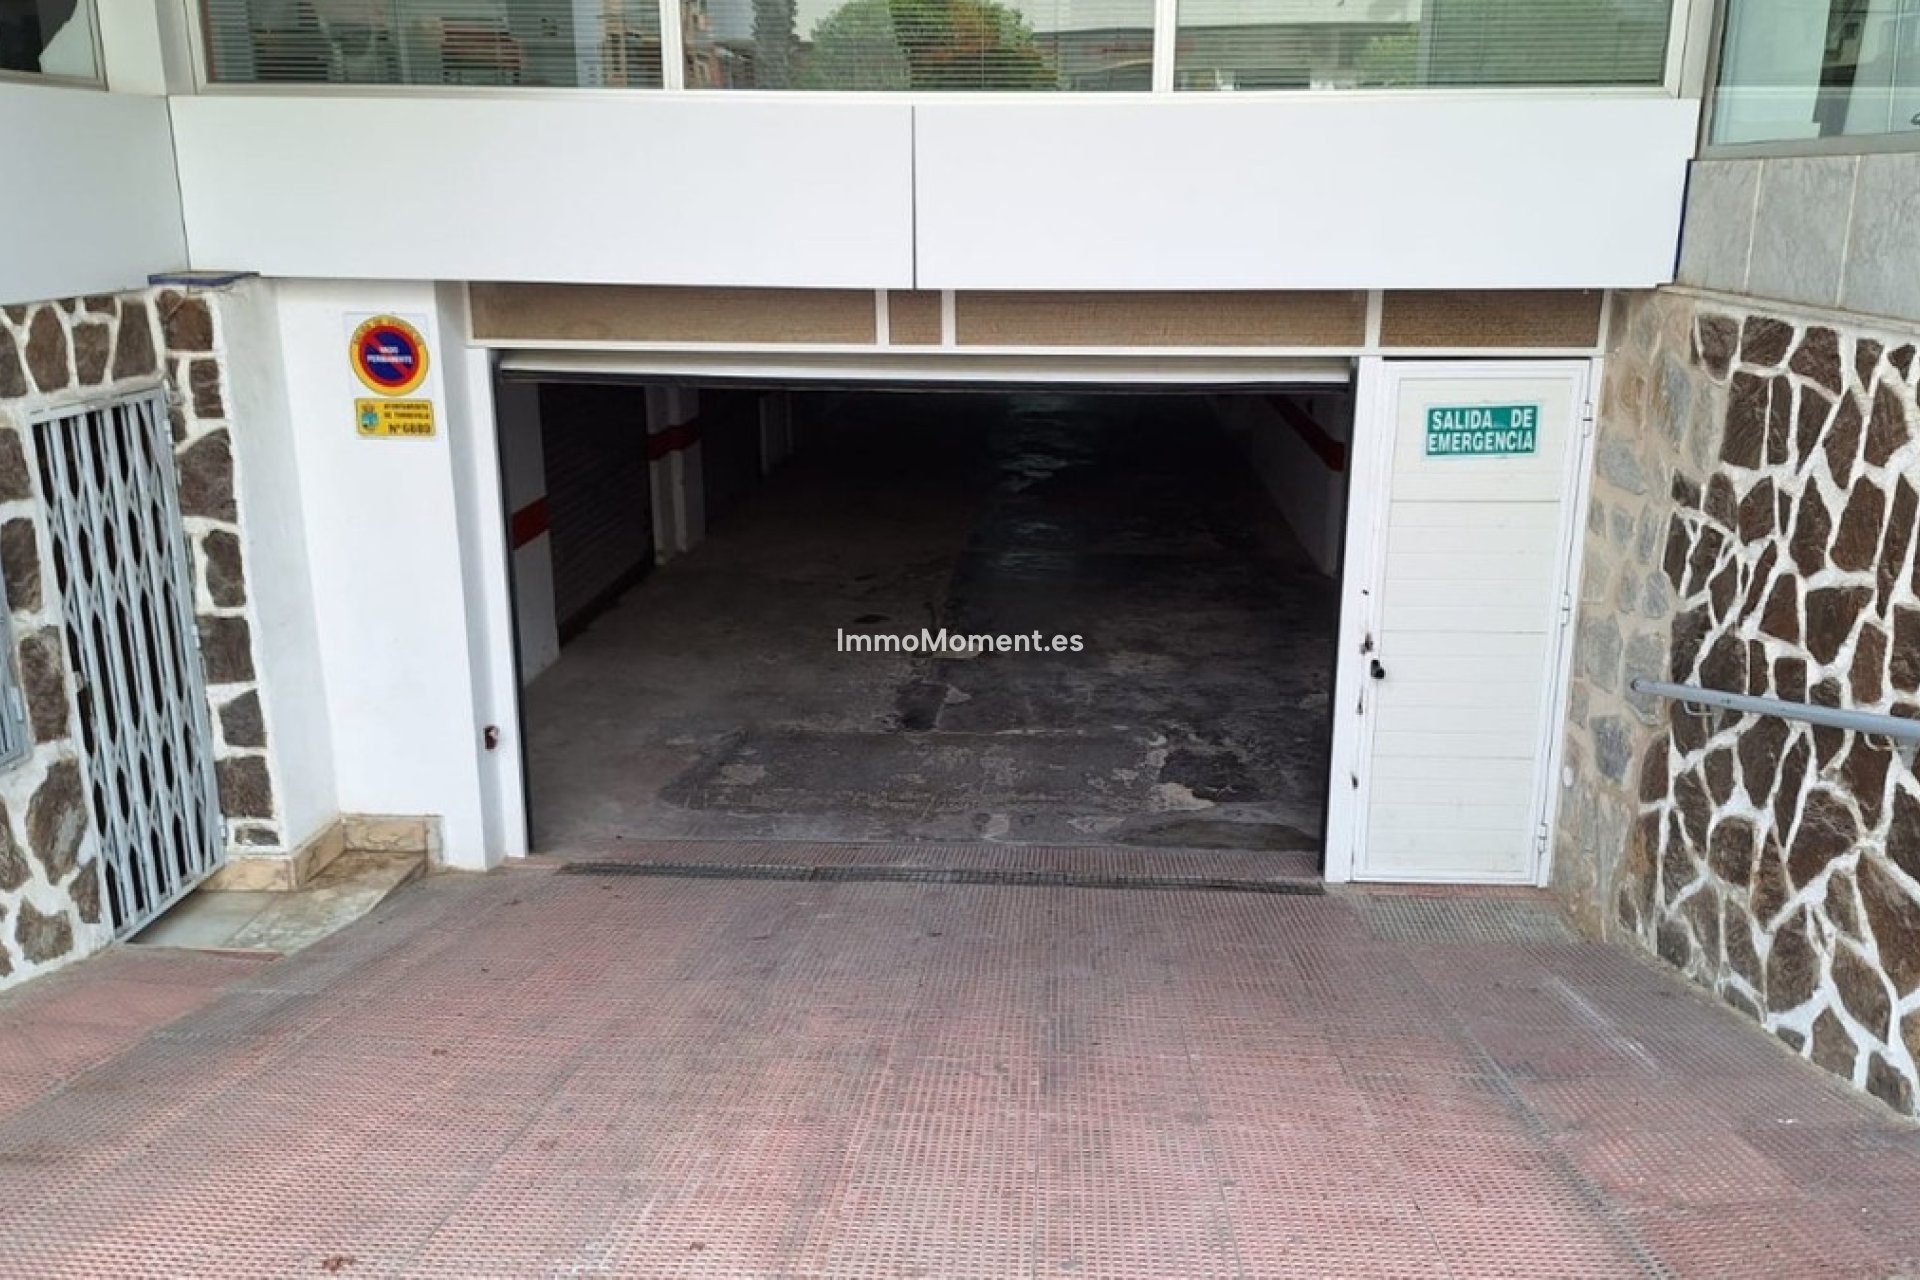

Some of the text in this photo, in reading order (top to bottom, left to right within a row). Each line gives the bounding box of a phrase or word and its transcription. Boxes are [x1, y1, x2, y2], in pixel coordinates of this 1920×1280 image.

[1432, 408, 1534, 430] SALIDA DE
[1428, 430, 1533, 452] EMERGENCIA
